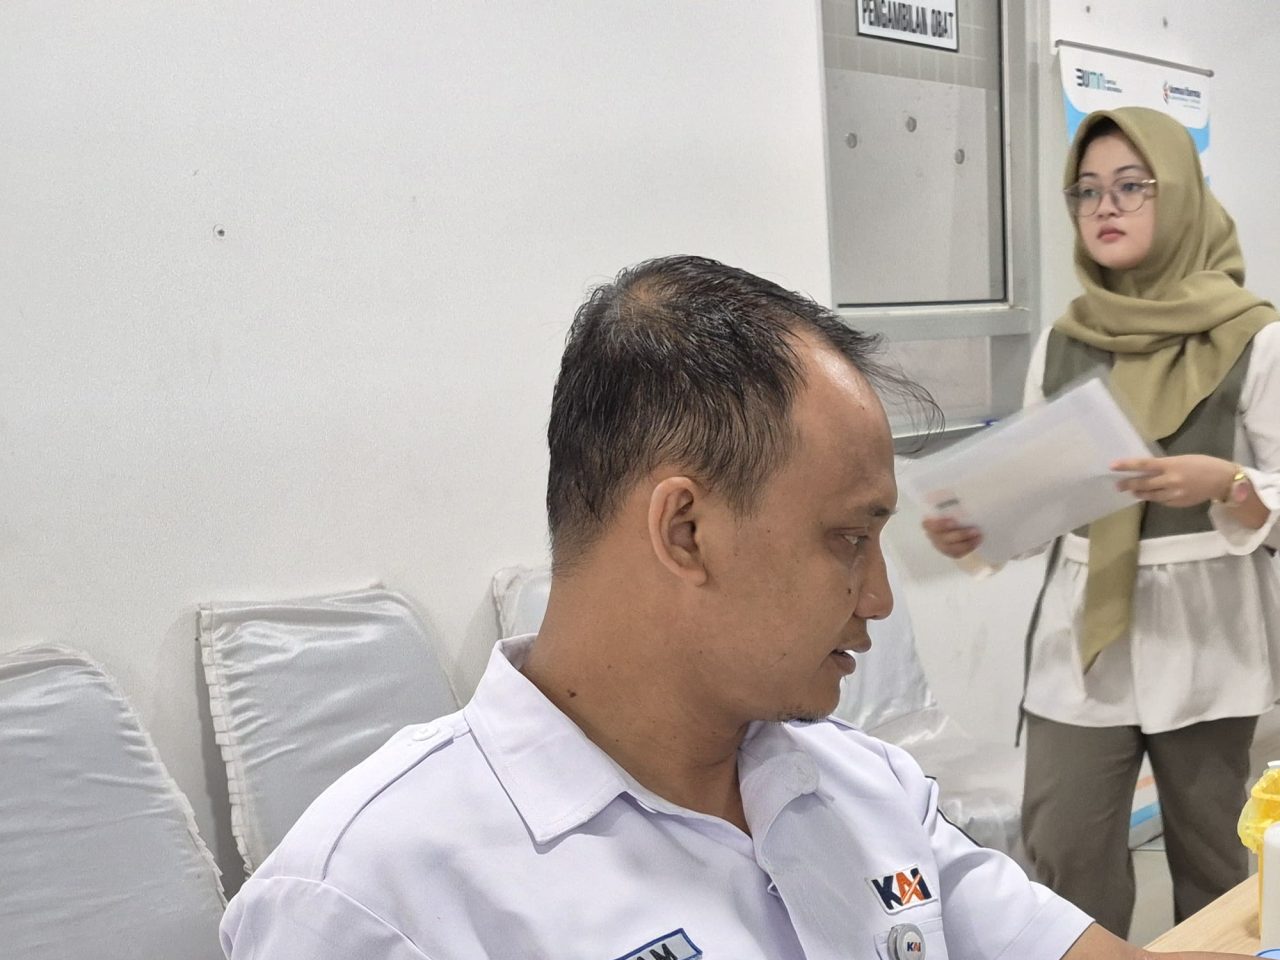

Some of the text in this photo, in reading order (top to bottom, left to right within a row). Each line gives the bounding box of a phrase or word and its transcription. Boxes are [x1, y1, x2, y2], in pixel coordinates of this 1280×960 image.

[862, 0, 954, 39] PENGAMBILAN OBAT
[871, 867, 932, 911] KAI
[906, 941, 922, 953] KAI
